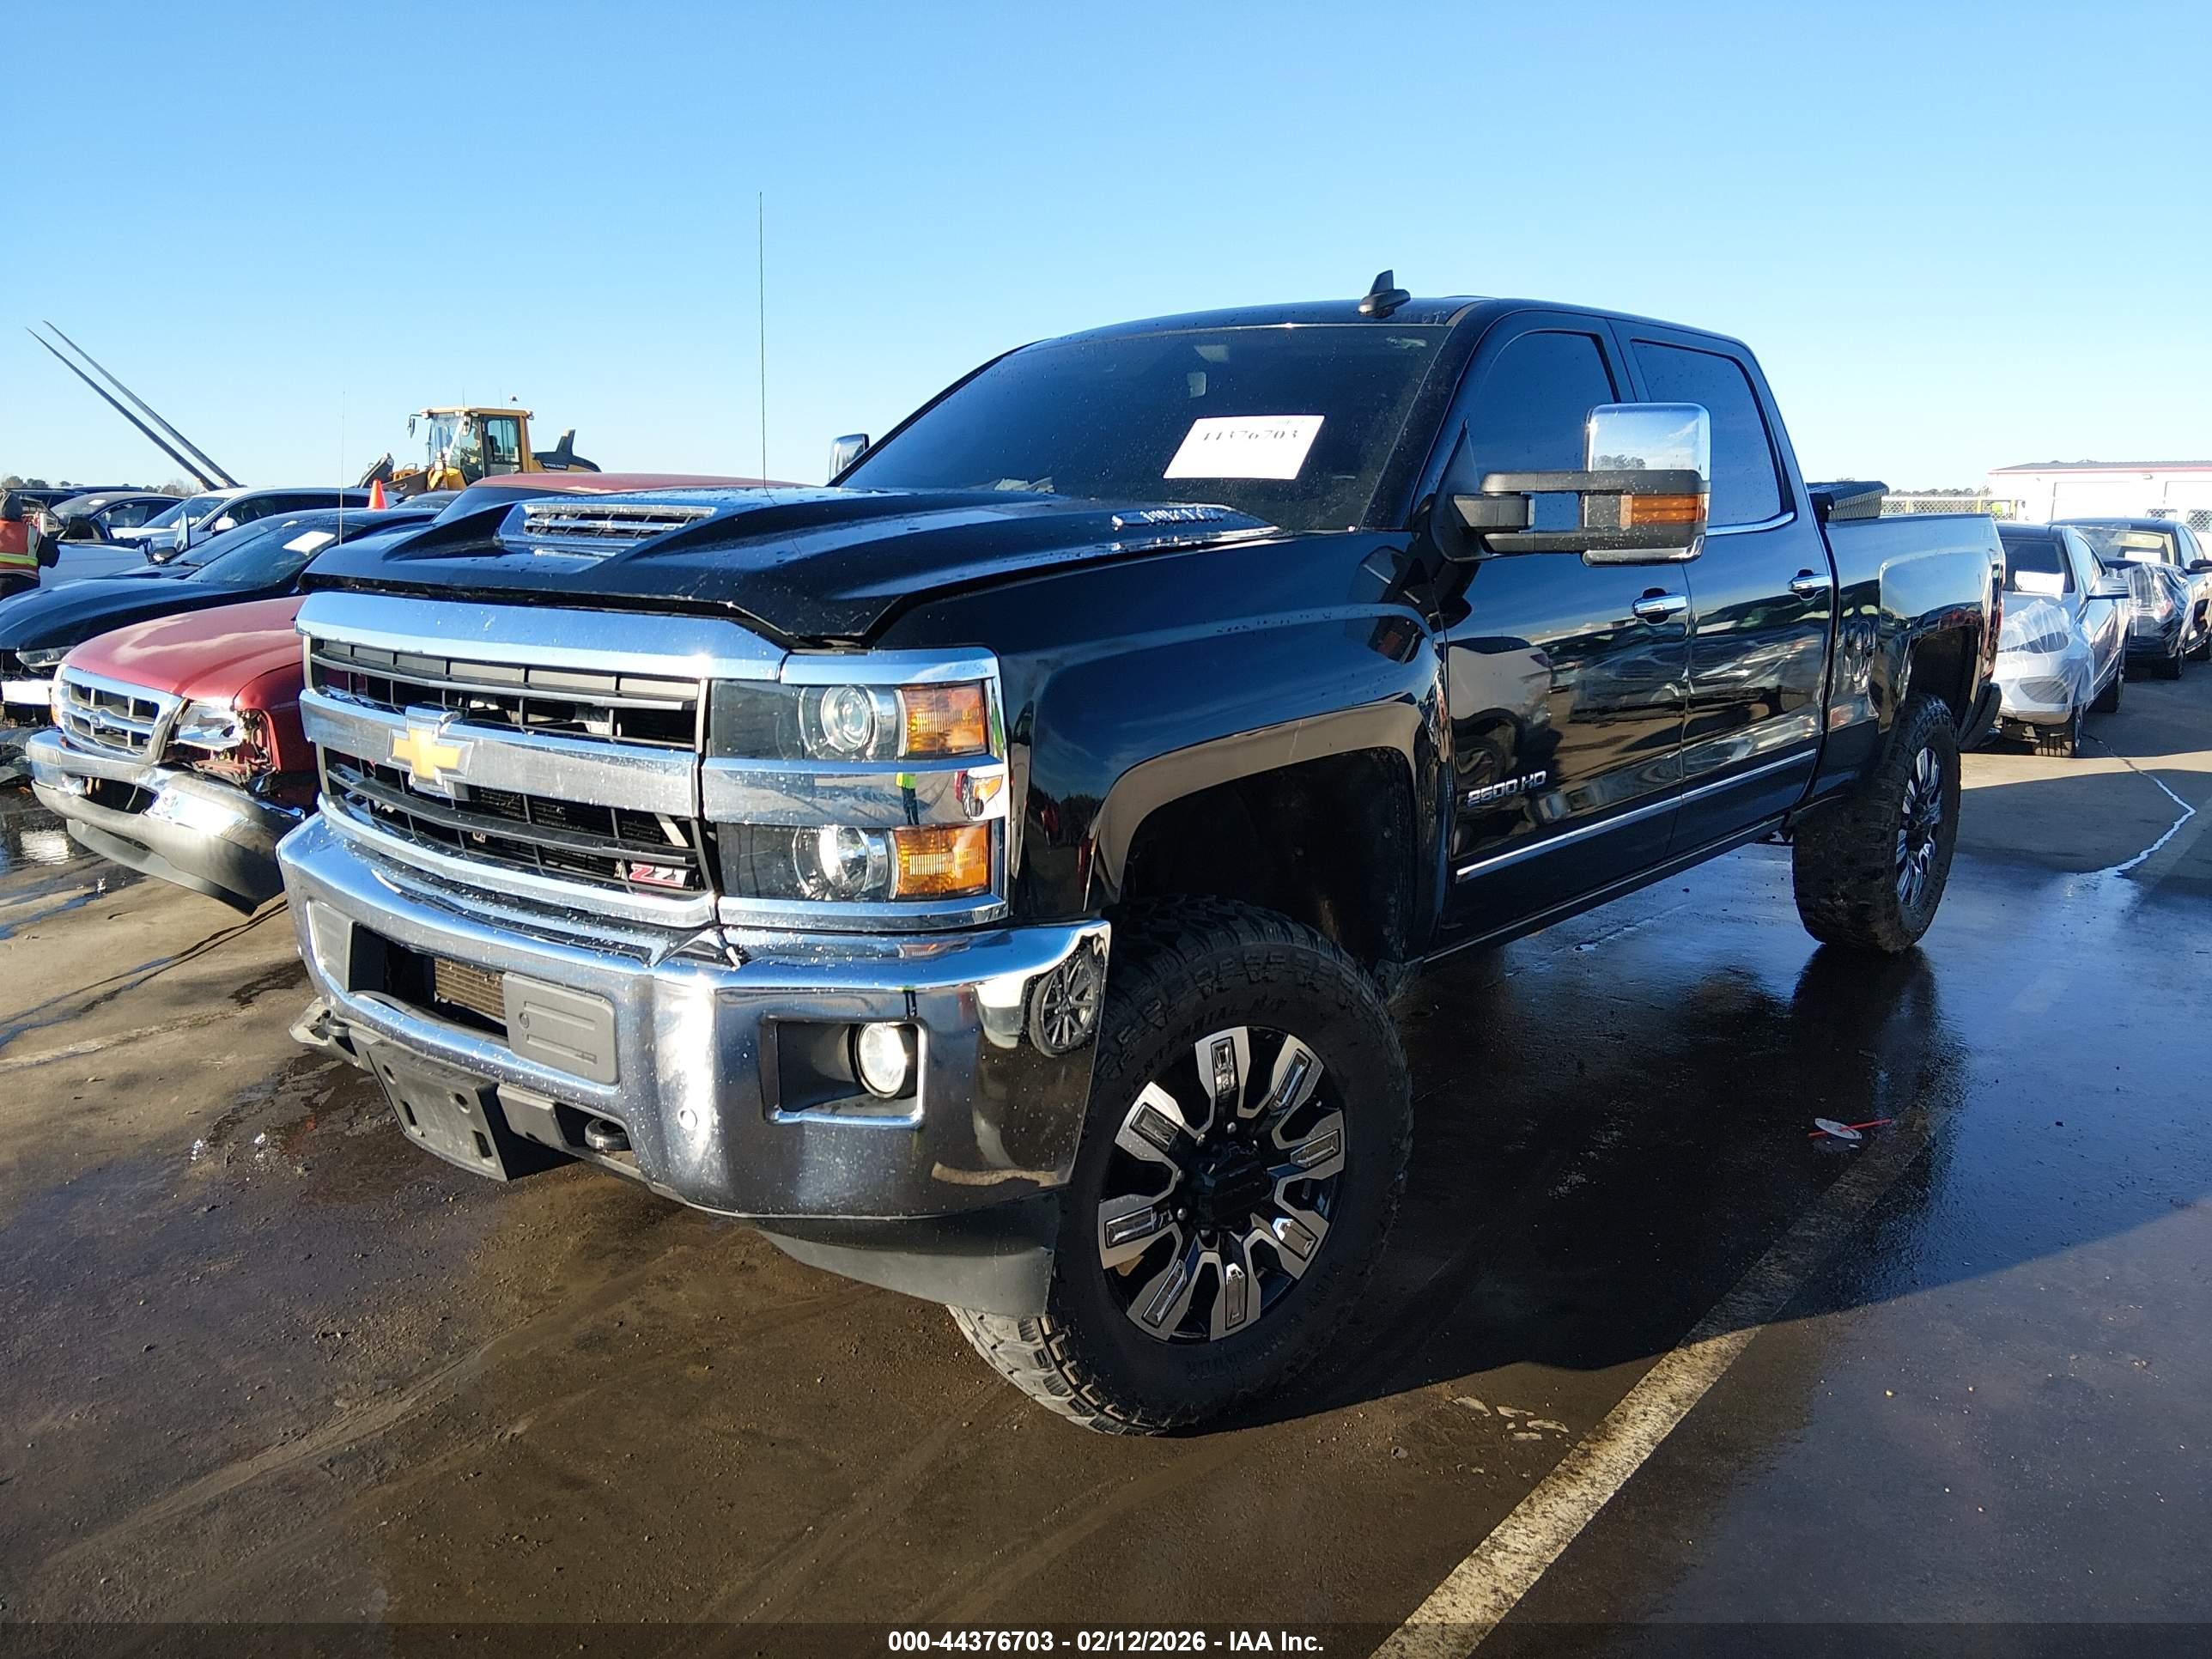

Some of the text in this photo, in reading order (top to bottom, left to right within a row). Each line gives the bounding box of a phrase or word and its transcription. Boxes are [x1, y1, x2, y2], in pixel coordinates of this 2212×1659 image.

[1467, 770, 1547, 805] 2500 HD
[629, 863, 687, 887] Z71
